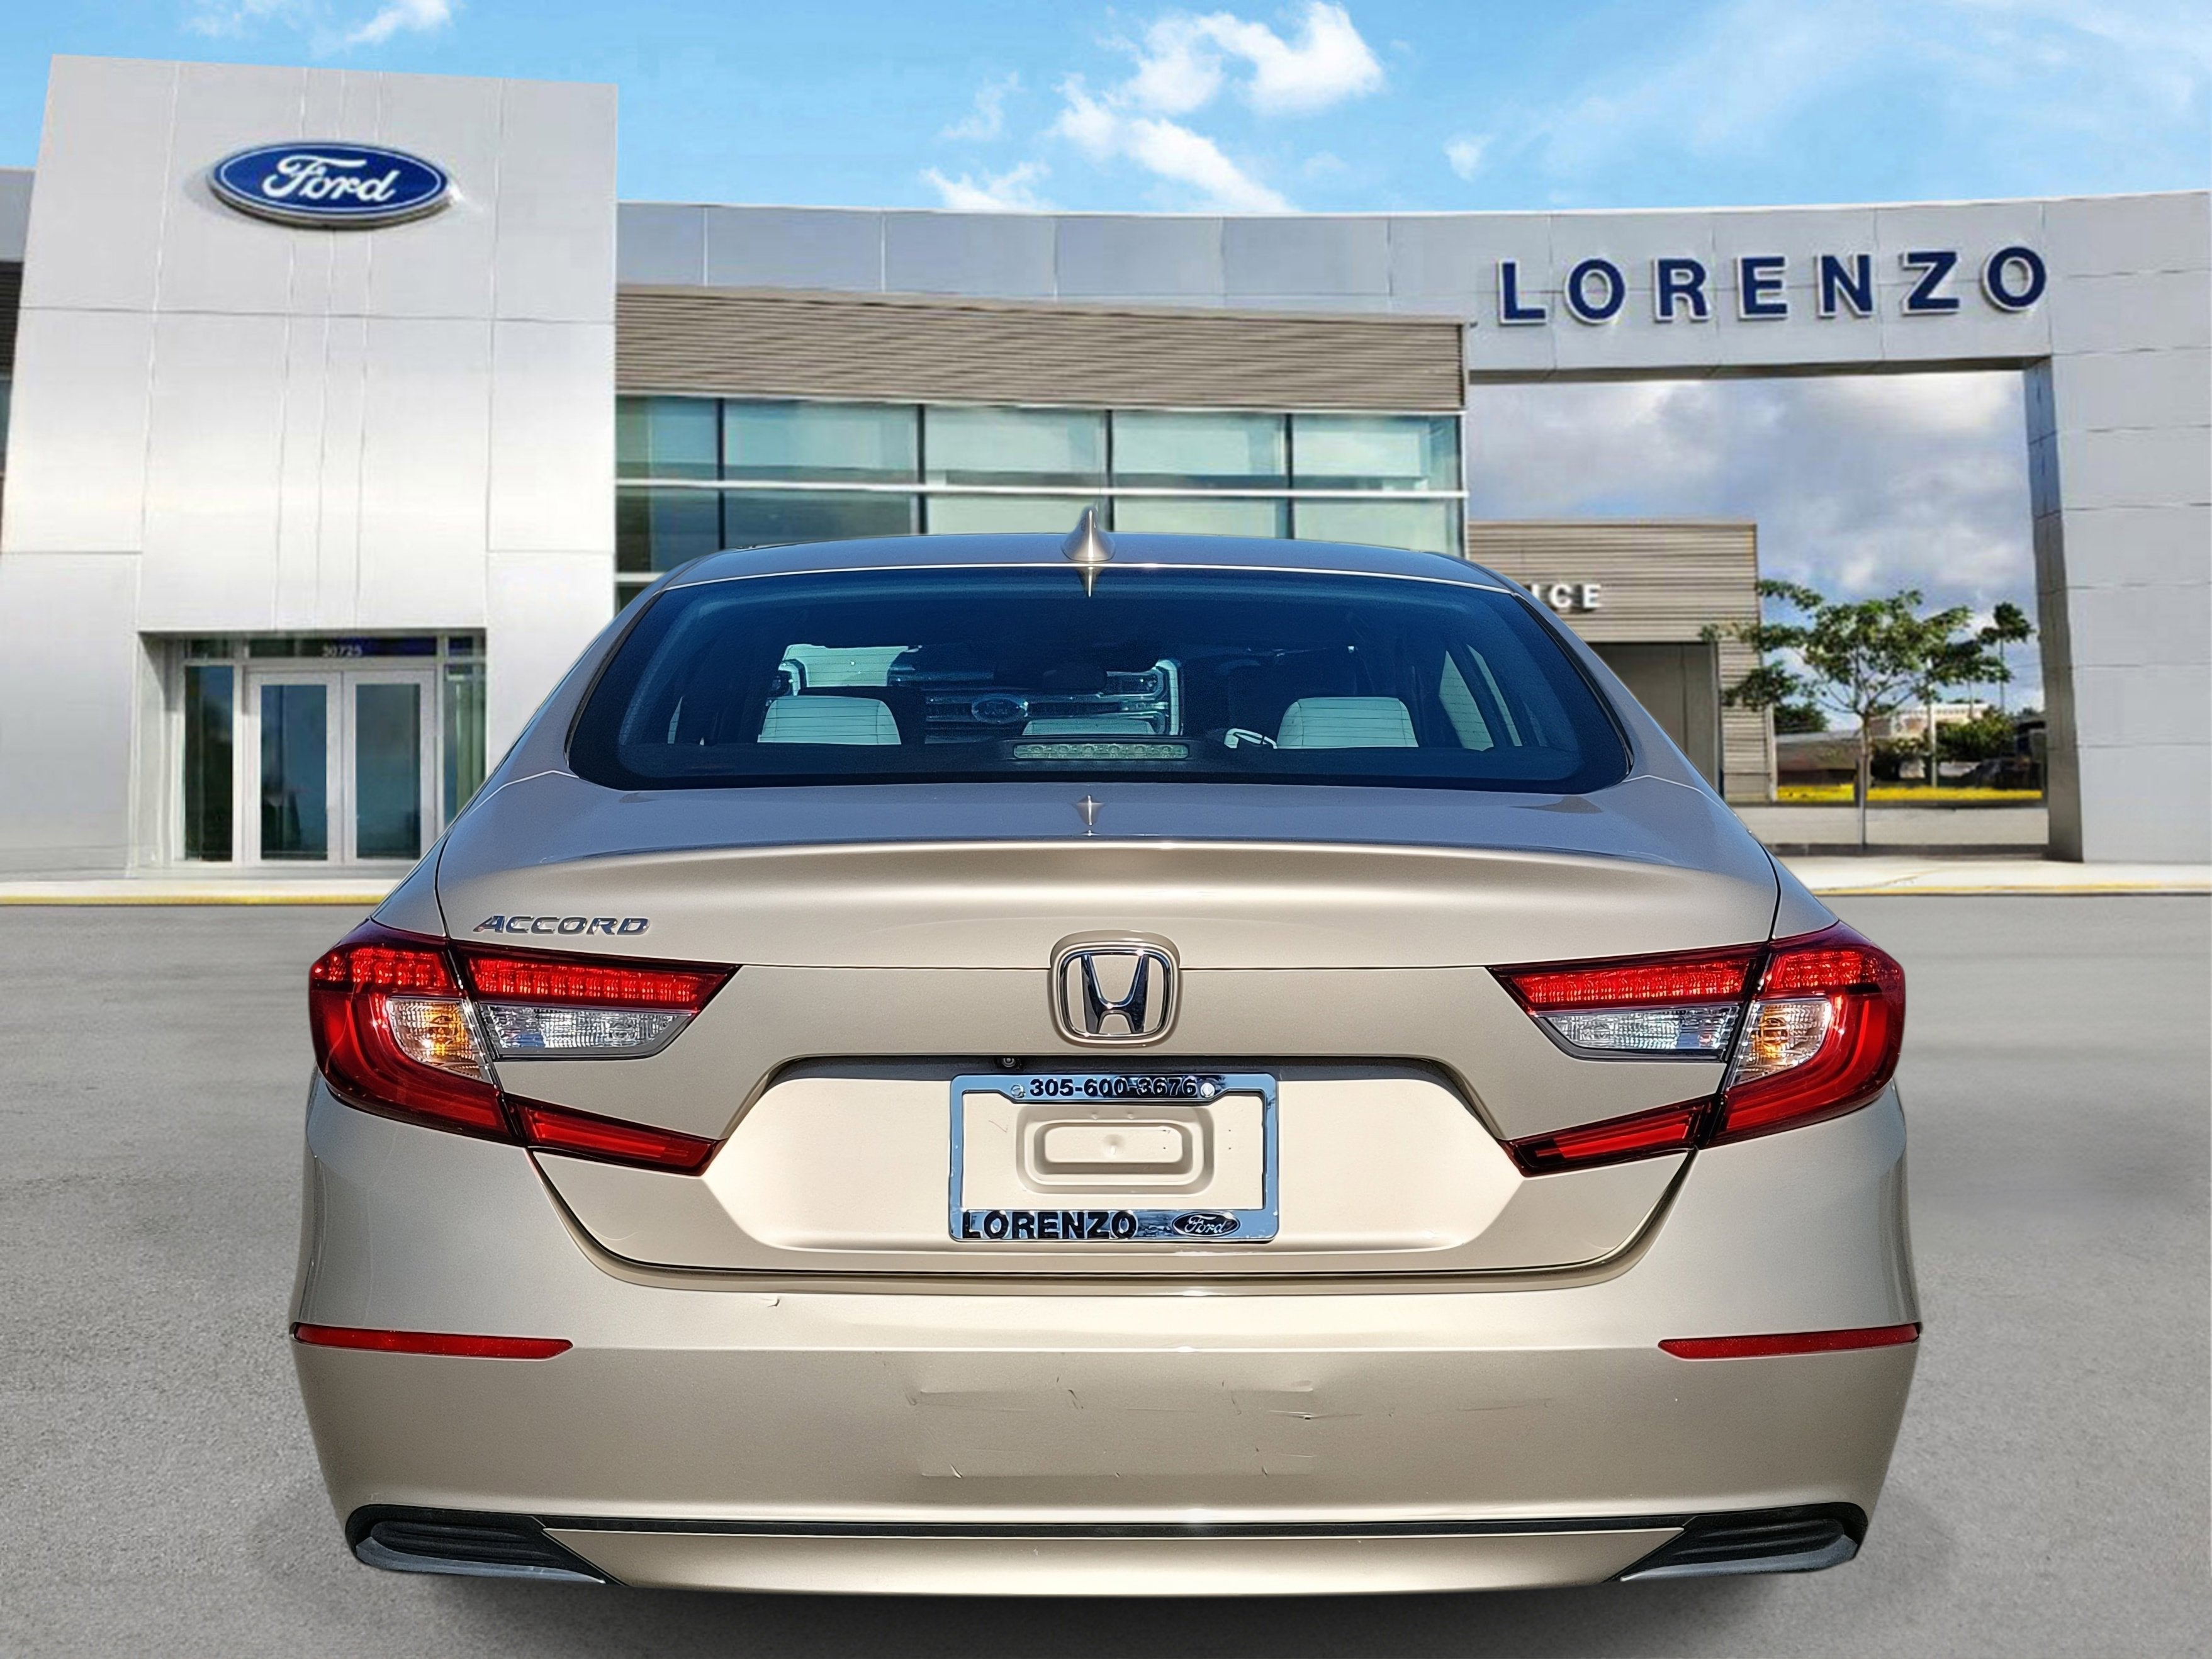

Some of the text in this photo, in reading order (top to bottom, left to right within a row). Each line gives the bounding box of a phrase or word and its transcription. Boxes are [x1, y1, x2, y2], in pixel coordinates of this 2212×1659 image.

[262, 154, 401, 202] Ford
[1498, 246, 2047, 325] LORENZO
[473, 915, 651, 936] ACCORD
[1030, 1077, 1197, 1097] 305-600-3676
[962, 1210, 1138, 1239] LORENZO
[1184, 1214, 1228, 1234] Ford
